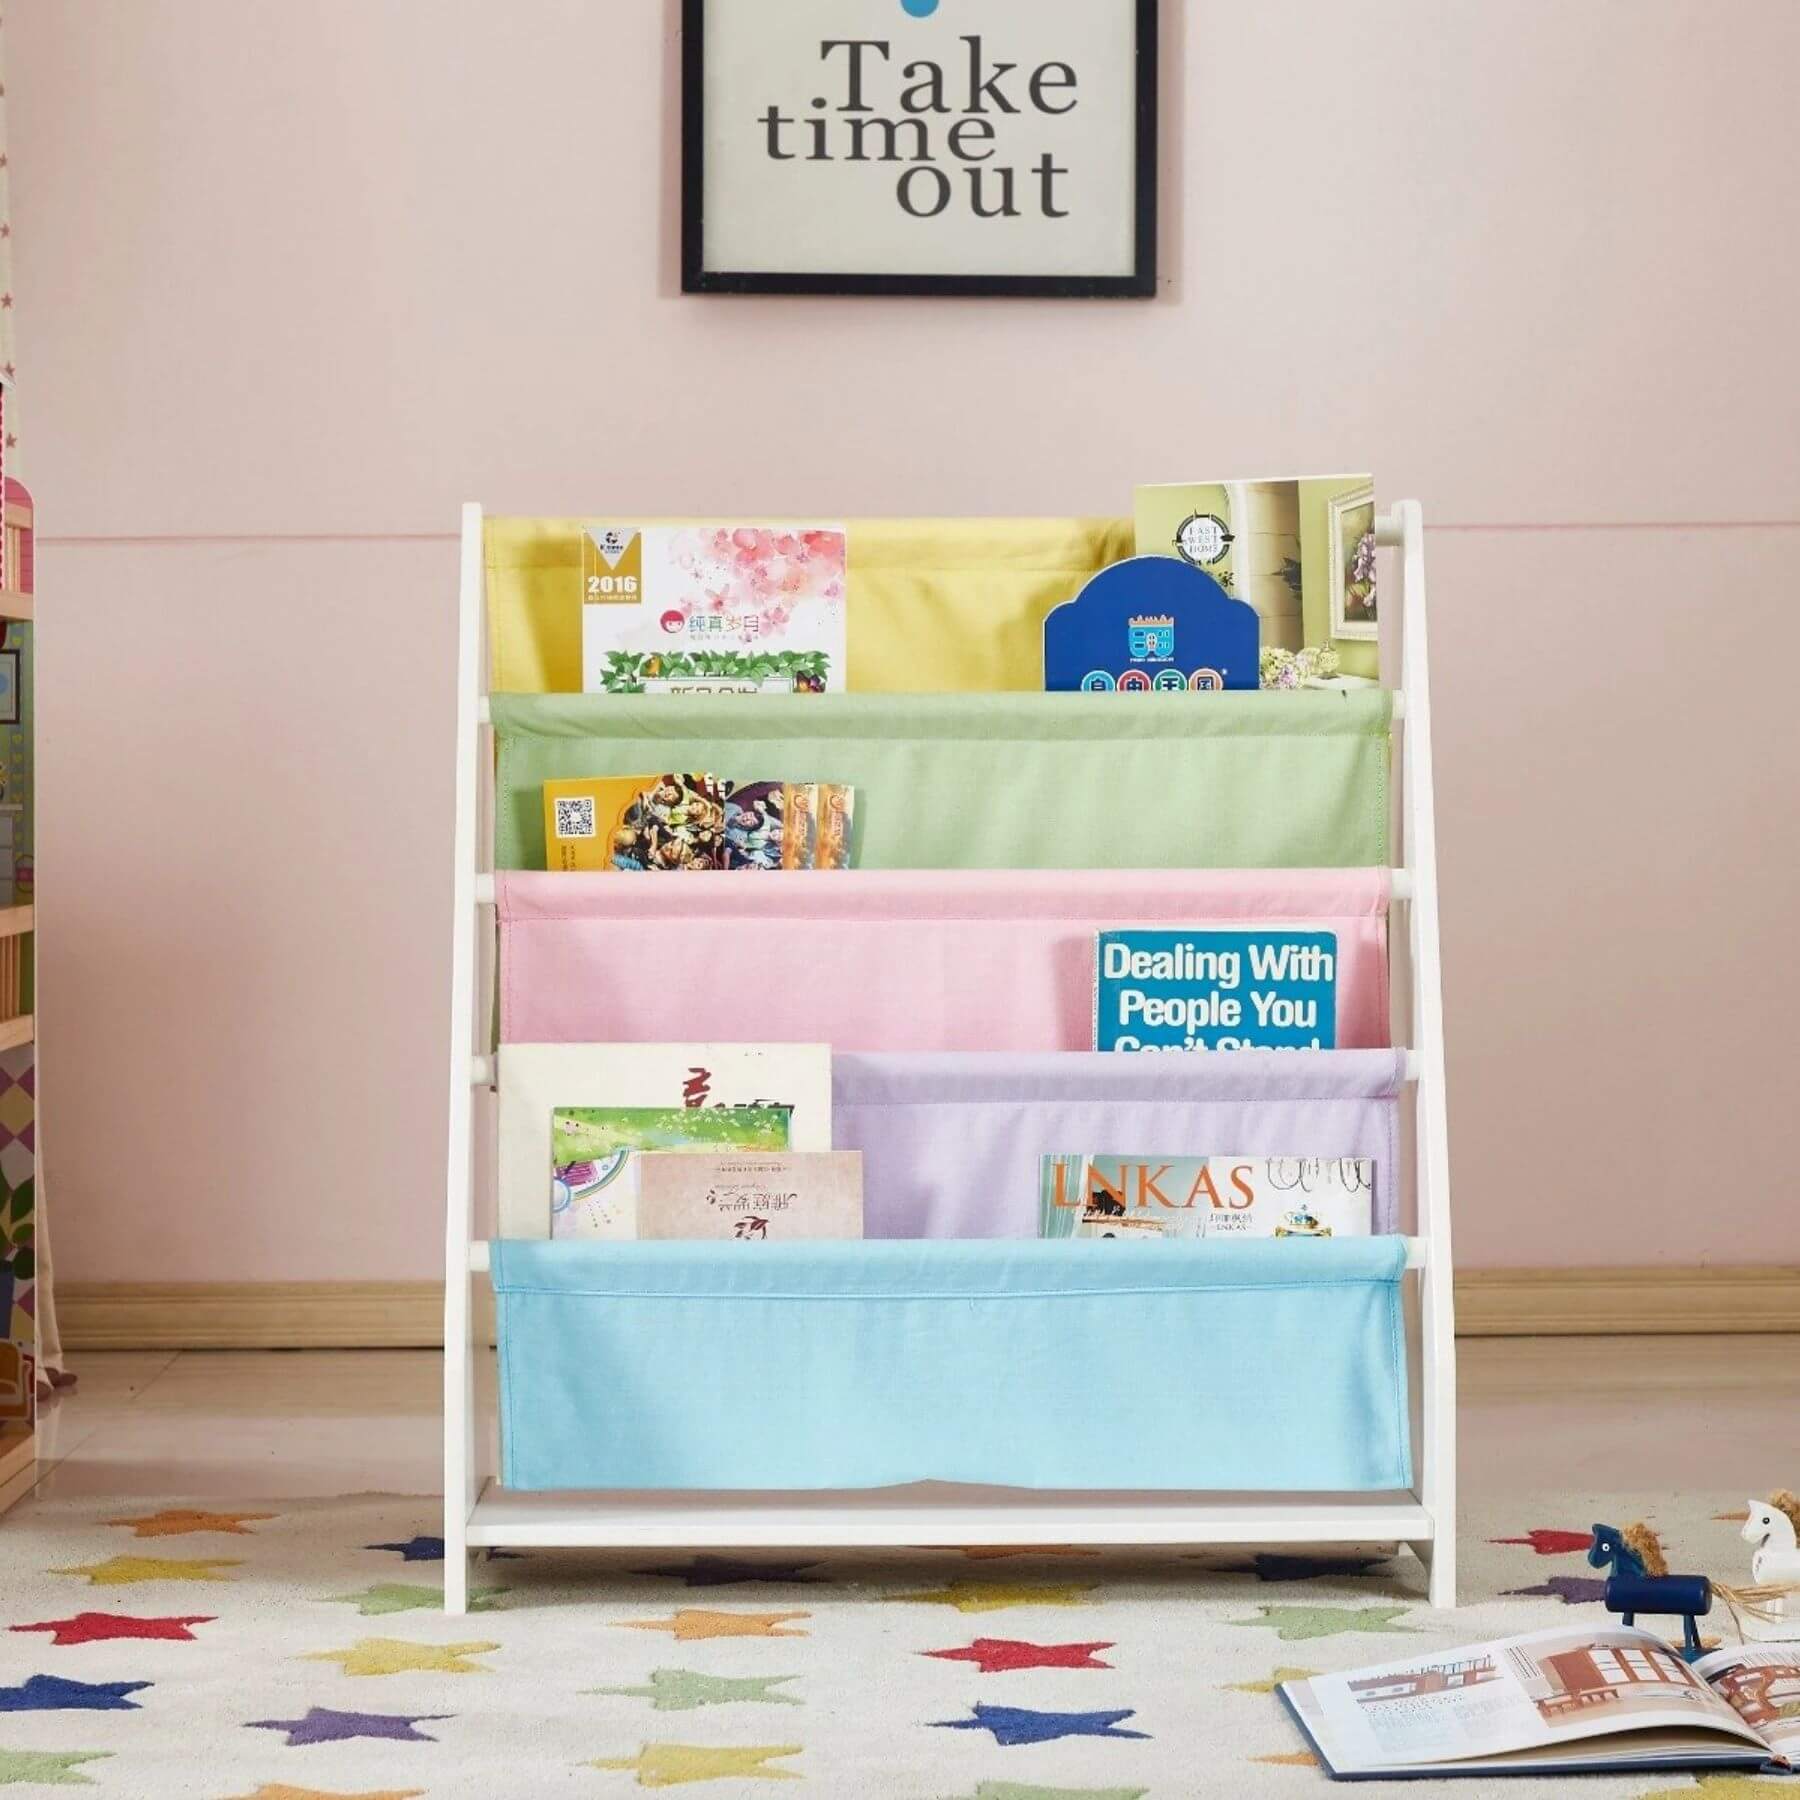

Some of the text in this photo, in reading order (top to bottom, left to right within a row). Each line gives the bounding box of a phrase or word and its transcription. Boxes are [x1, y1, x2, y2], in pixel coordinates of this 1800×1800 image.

[821, 36, 1077, 114] Take
[758, 97, 995, 161] time
[896, 153, 1069, 218] out
[587, 575, 638, 593] 2016
[1104, 943, 1334, 989] Dealing With
[1119, 989, 1317, 1036] People You
